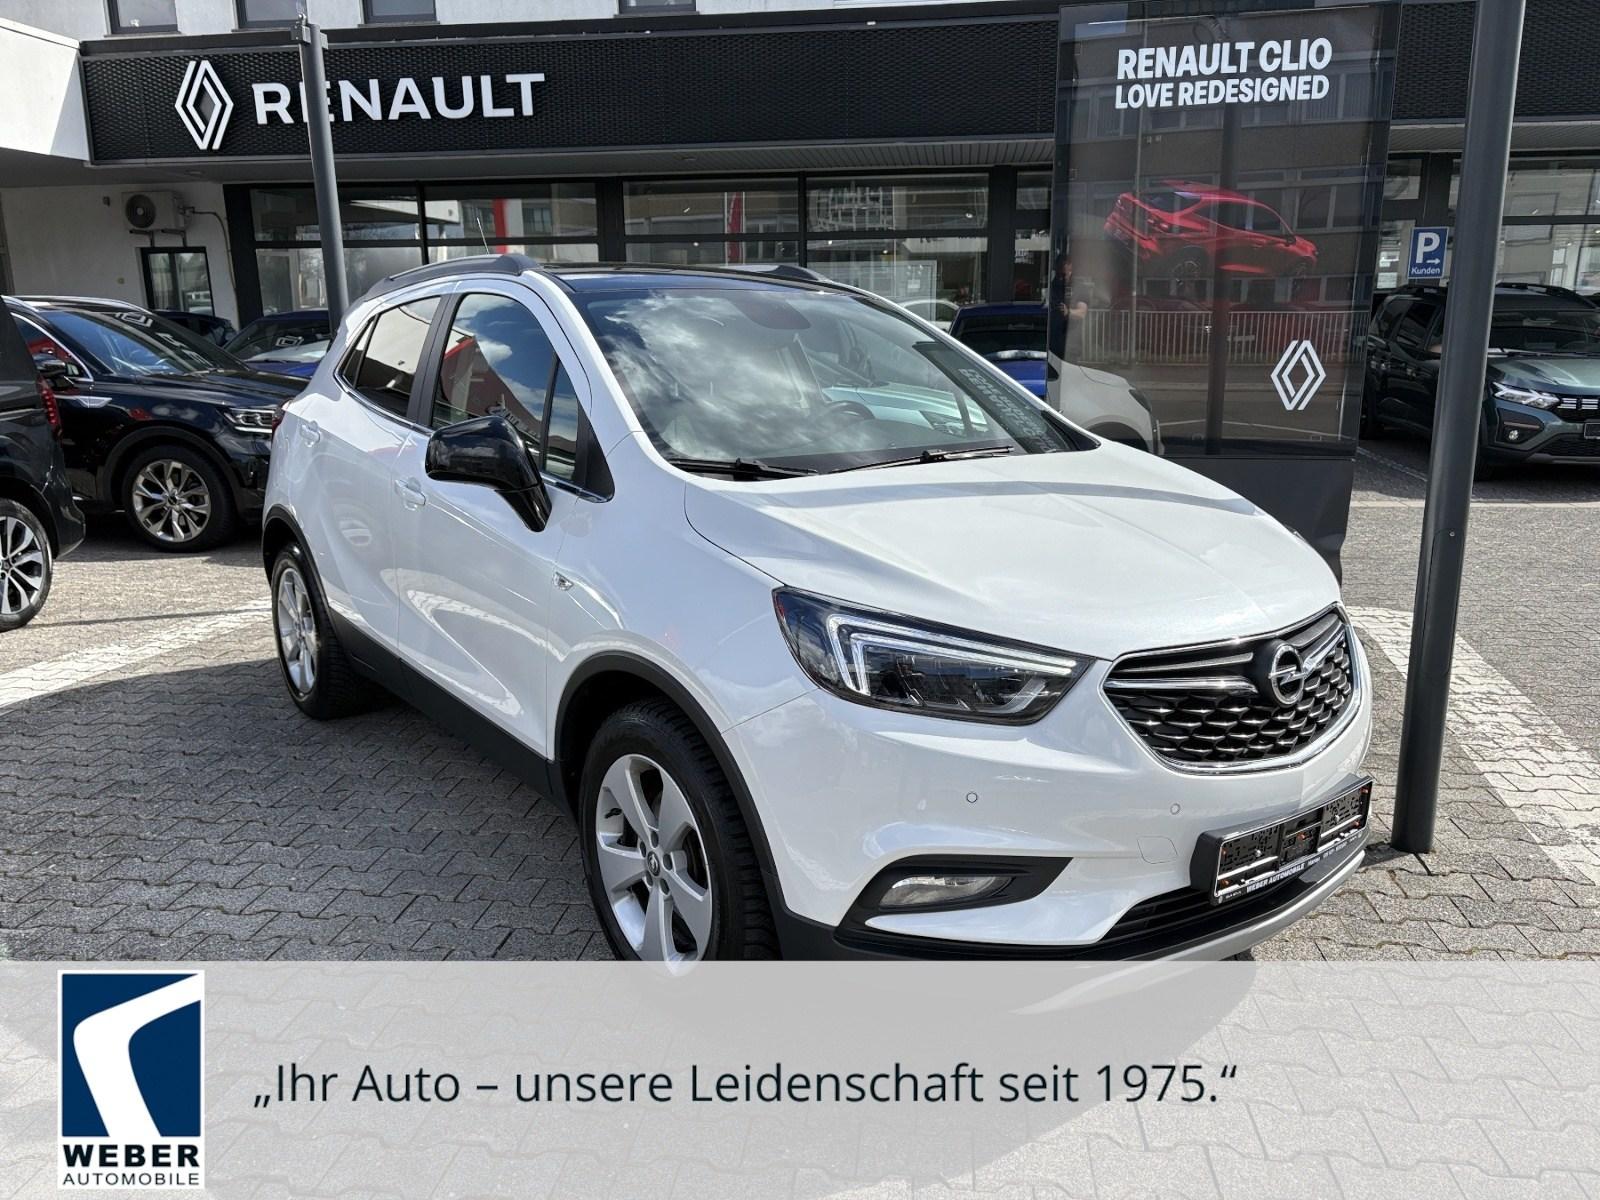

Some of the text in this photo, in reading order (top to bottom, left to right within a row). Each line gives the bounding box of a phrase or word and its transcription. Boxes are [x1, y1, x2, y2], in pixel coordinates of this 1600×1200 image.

[1117, 37, 1333, 80] RENAULT CLIO
[1115, 74, 1330, 110] LOVE REDESIGNED
[1415, 231, 1441, 264] P
[1410, 266, 1441, 275] Kunden
[1268, 863, 1305, 884] AUTOMOBILE
